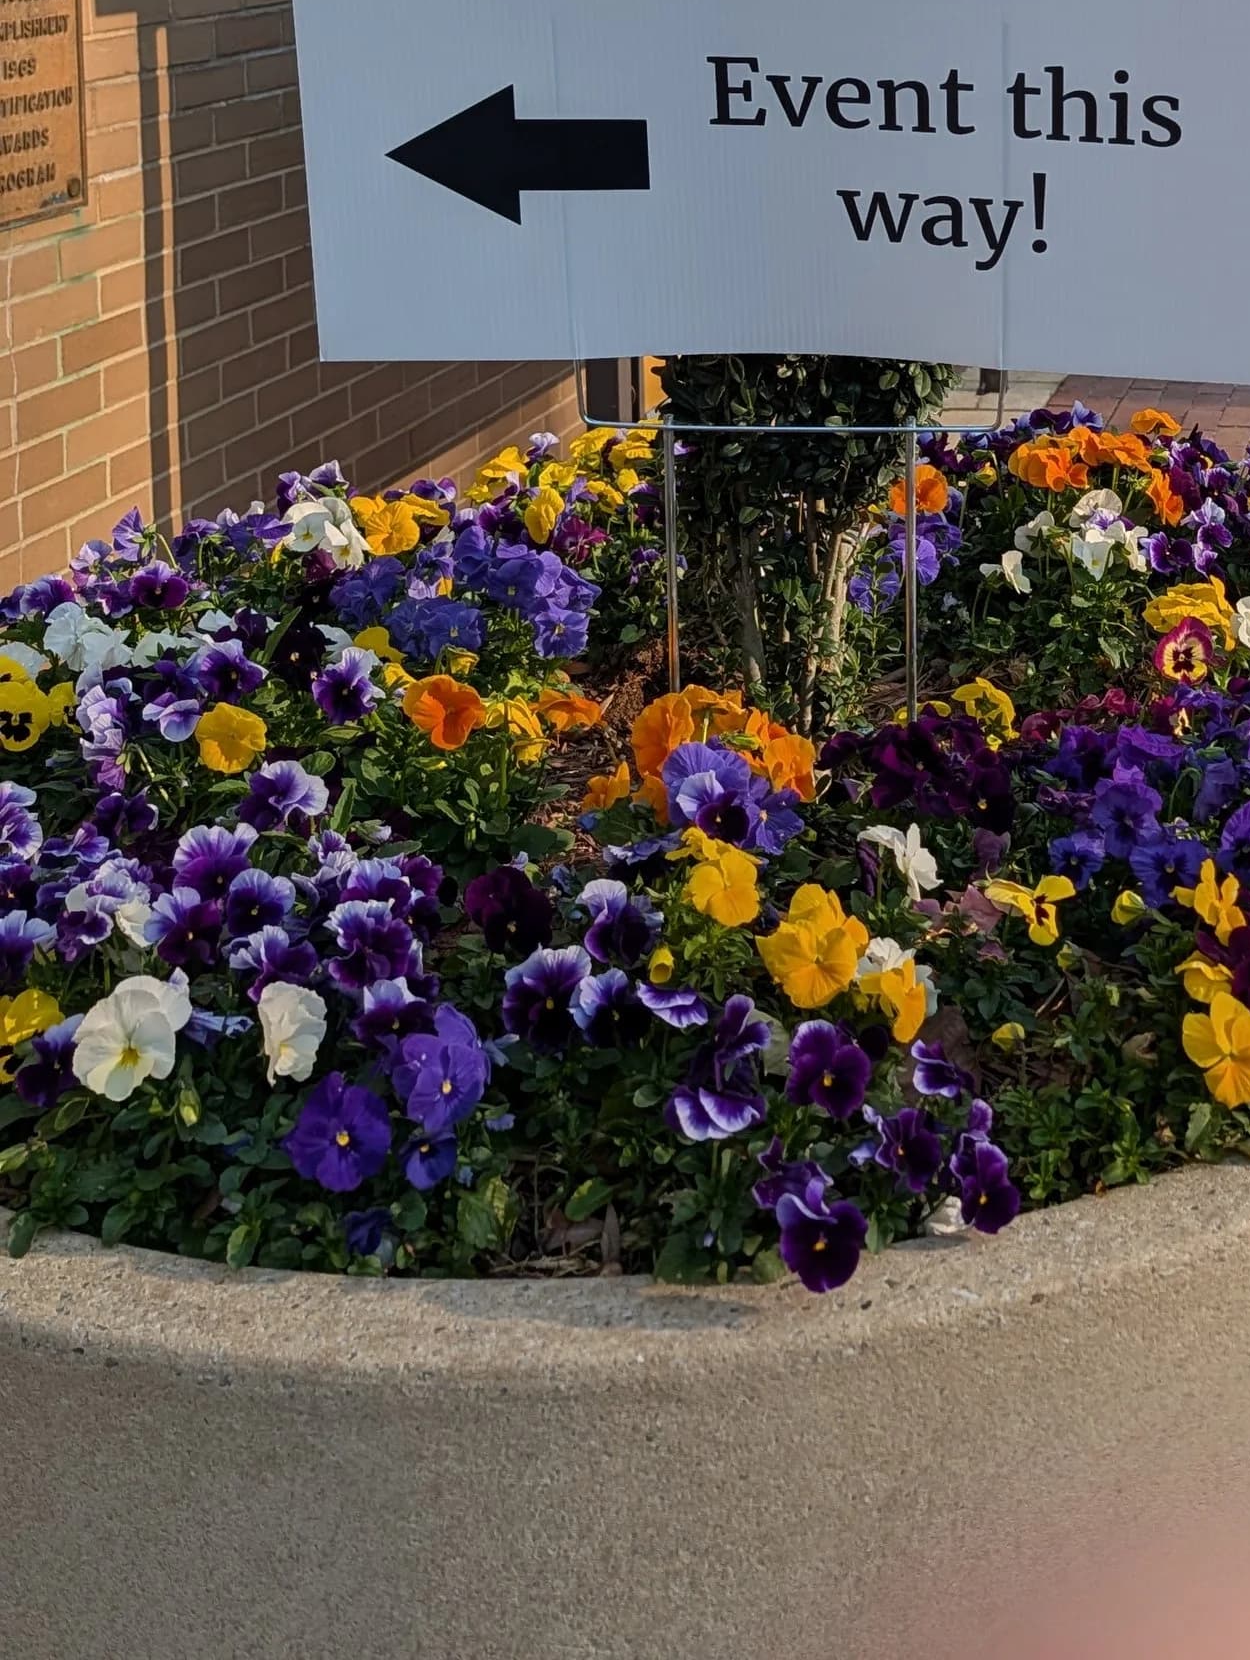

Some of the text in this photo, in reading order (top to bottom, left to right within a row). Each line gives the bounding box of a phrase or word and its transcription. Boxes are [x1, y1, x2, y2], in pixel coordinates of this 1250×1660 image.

[3, 57, 37, 81] 1969
[707, 56, 1182, 148] Event this
[0, 128, 50, 156] WARDS
[836, 172, 1048, 271] way!
